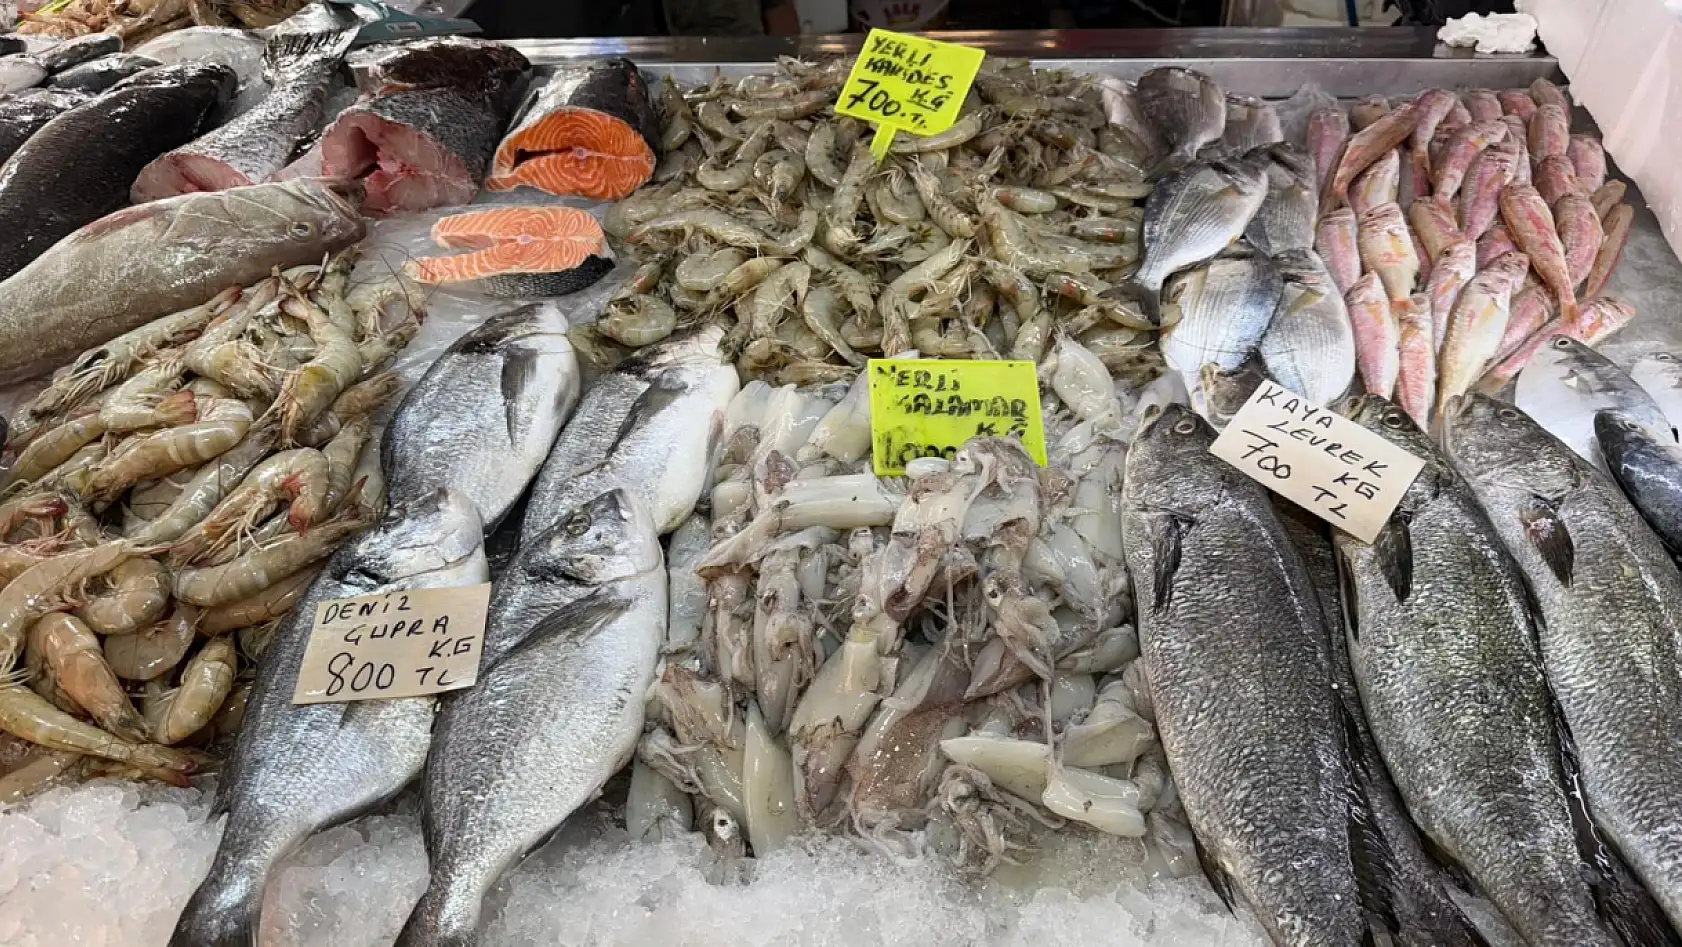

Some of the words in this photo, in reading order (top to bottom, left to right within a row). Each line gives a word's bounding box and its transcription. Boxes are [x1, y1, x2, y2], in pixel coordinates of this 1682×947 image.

[1256, 385, 1334, 429] KAYA
[1266, 420, 1389, 478] LEVREK
[1240, 429, 1291, 479] 700
[1311, 485, 1349, 520] TL
[1332, 471, 1381, 501] KG
[325, 652, 395, 697] 800
[415, 667, 454, 686] TL
